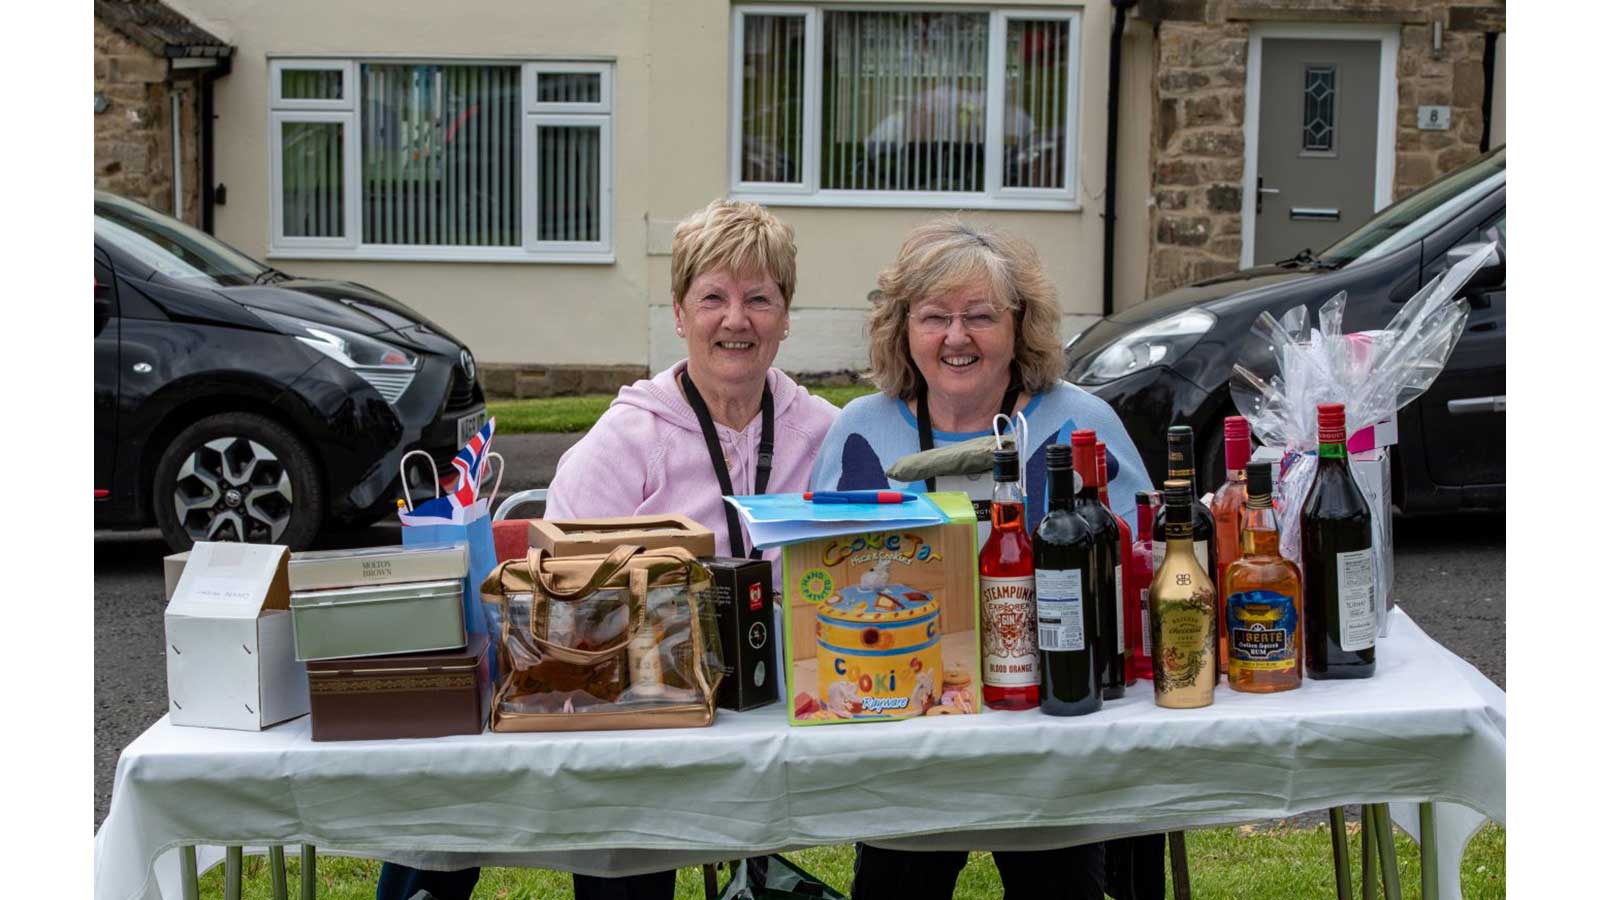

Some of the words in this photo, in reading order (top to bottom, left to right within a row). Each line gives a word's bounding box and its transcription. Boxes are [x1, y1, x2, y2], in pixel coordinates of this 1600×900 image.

[1430, 109, 1439, 123] 8
[903, 532, 944, 564] Jar
[361, 569, 392, 577] BROWN
[983, 585, 1035, 602] STEAMPUNK
[1001, 614, 1015, 625] GIN
[989, 663, 1008, 673] BLOOD
[1009, 663, 1033, 673] ORANGE
